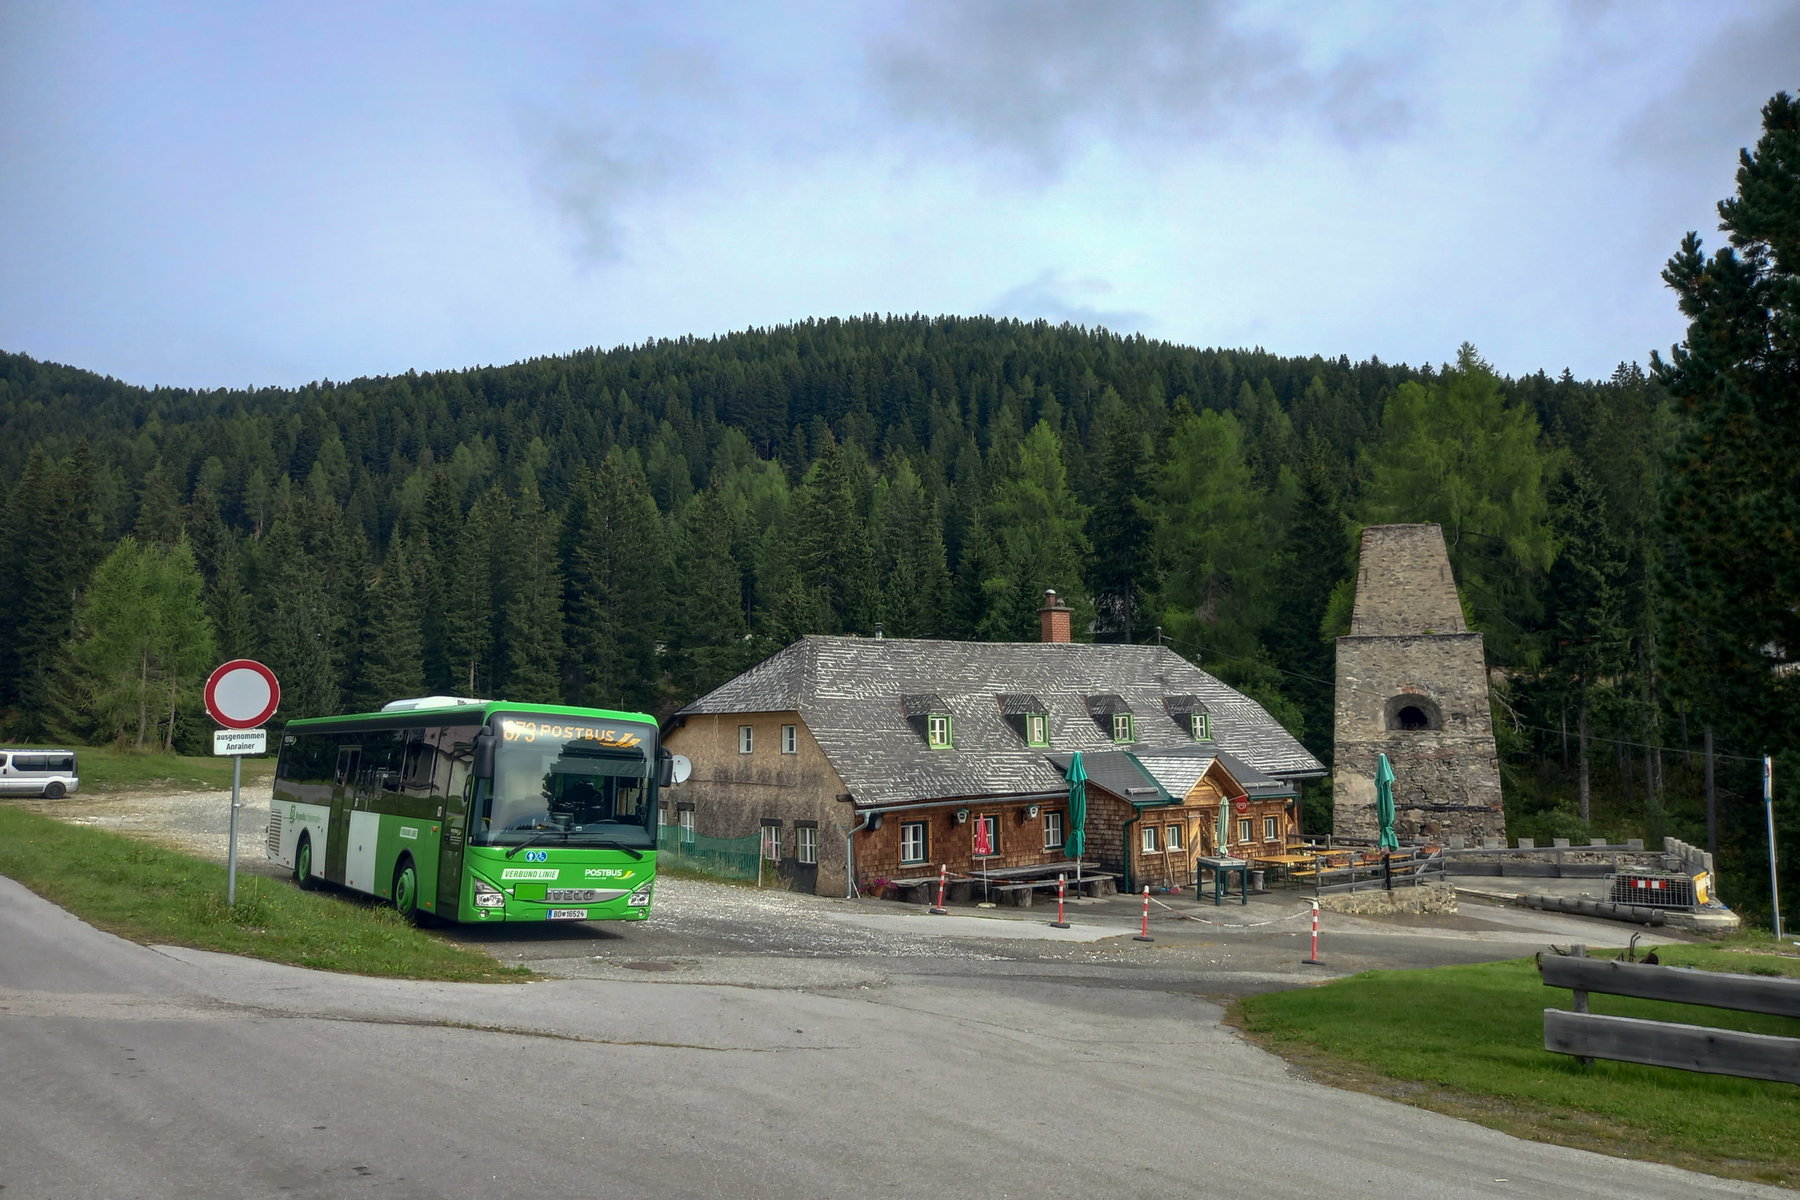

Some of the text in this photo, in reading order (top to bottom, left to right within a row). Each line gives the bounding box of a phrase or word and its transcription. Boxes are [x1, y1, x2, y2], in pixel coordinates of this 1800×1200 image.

[540, 724, 616, 741] POSTBUS
[216, 733, 265, 741] ausgenommen
[226, 742, 255, 750] Anrainer
[504, 870, 557, 878] VERBUND LINIE
